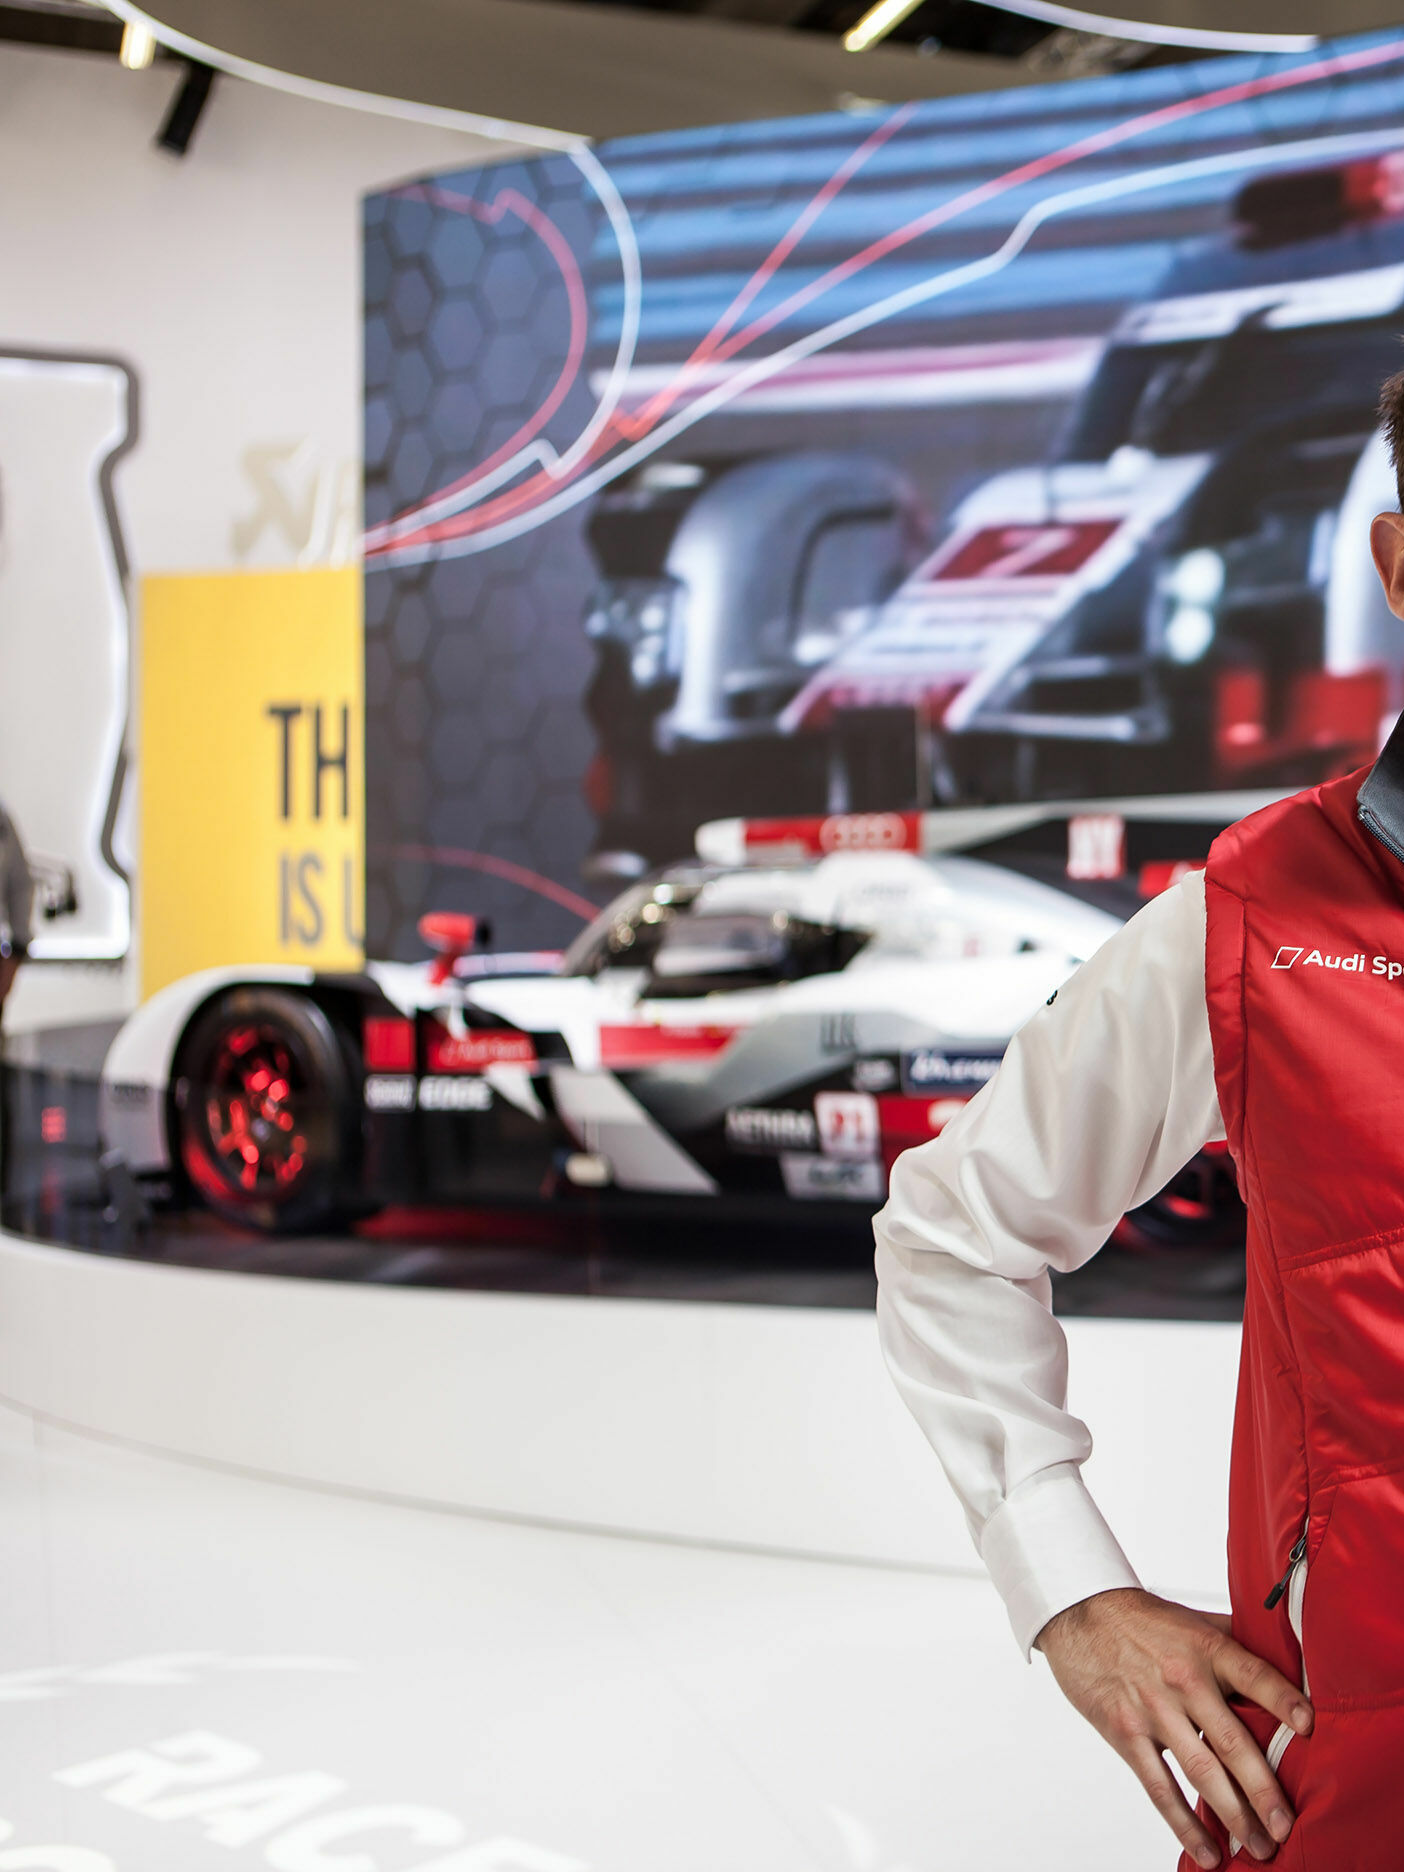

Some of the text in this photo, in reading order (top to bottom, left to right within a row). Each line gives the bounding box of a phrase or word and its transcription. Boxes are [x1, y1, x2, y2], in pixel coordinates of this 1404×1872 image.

[267, 703, 350, 820] TH
[280, 853, 324, 945] IS
[1302, 950, 1366, 973] Audi
